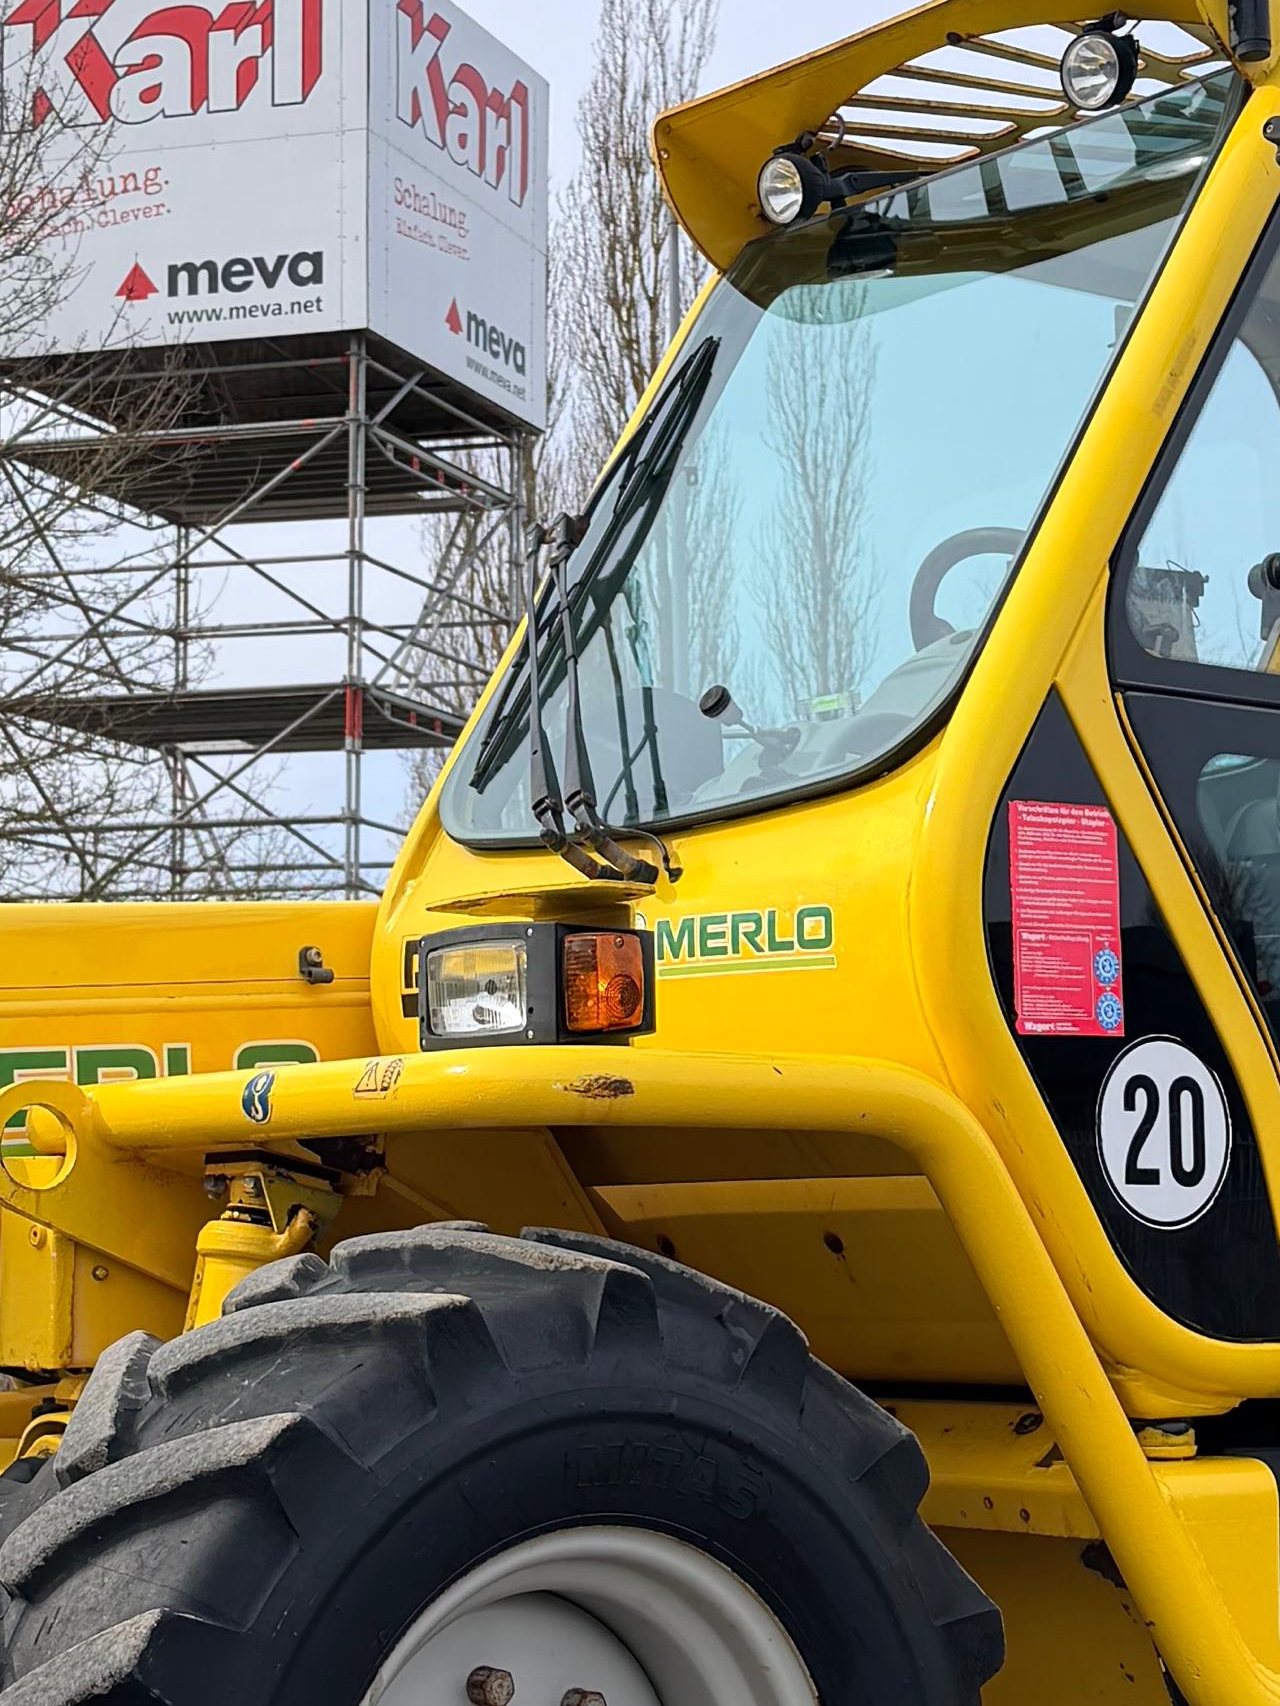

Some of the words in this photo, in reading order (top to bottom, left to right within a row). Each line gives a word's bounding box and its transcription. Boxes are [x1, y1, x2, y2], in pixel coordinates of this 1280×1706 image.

[97, 202, 172, 228] Clever.
[168, 250, 324, 298] meva
[167, 295, 324, 325] www.meva.net
[466, 310, 526, 377] meva
[655, 904, 835, 962] MERLO
[1122, 1073, 1207, 1188] 20
